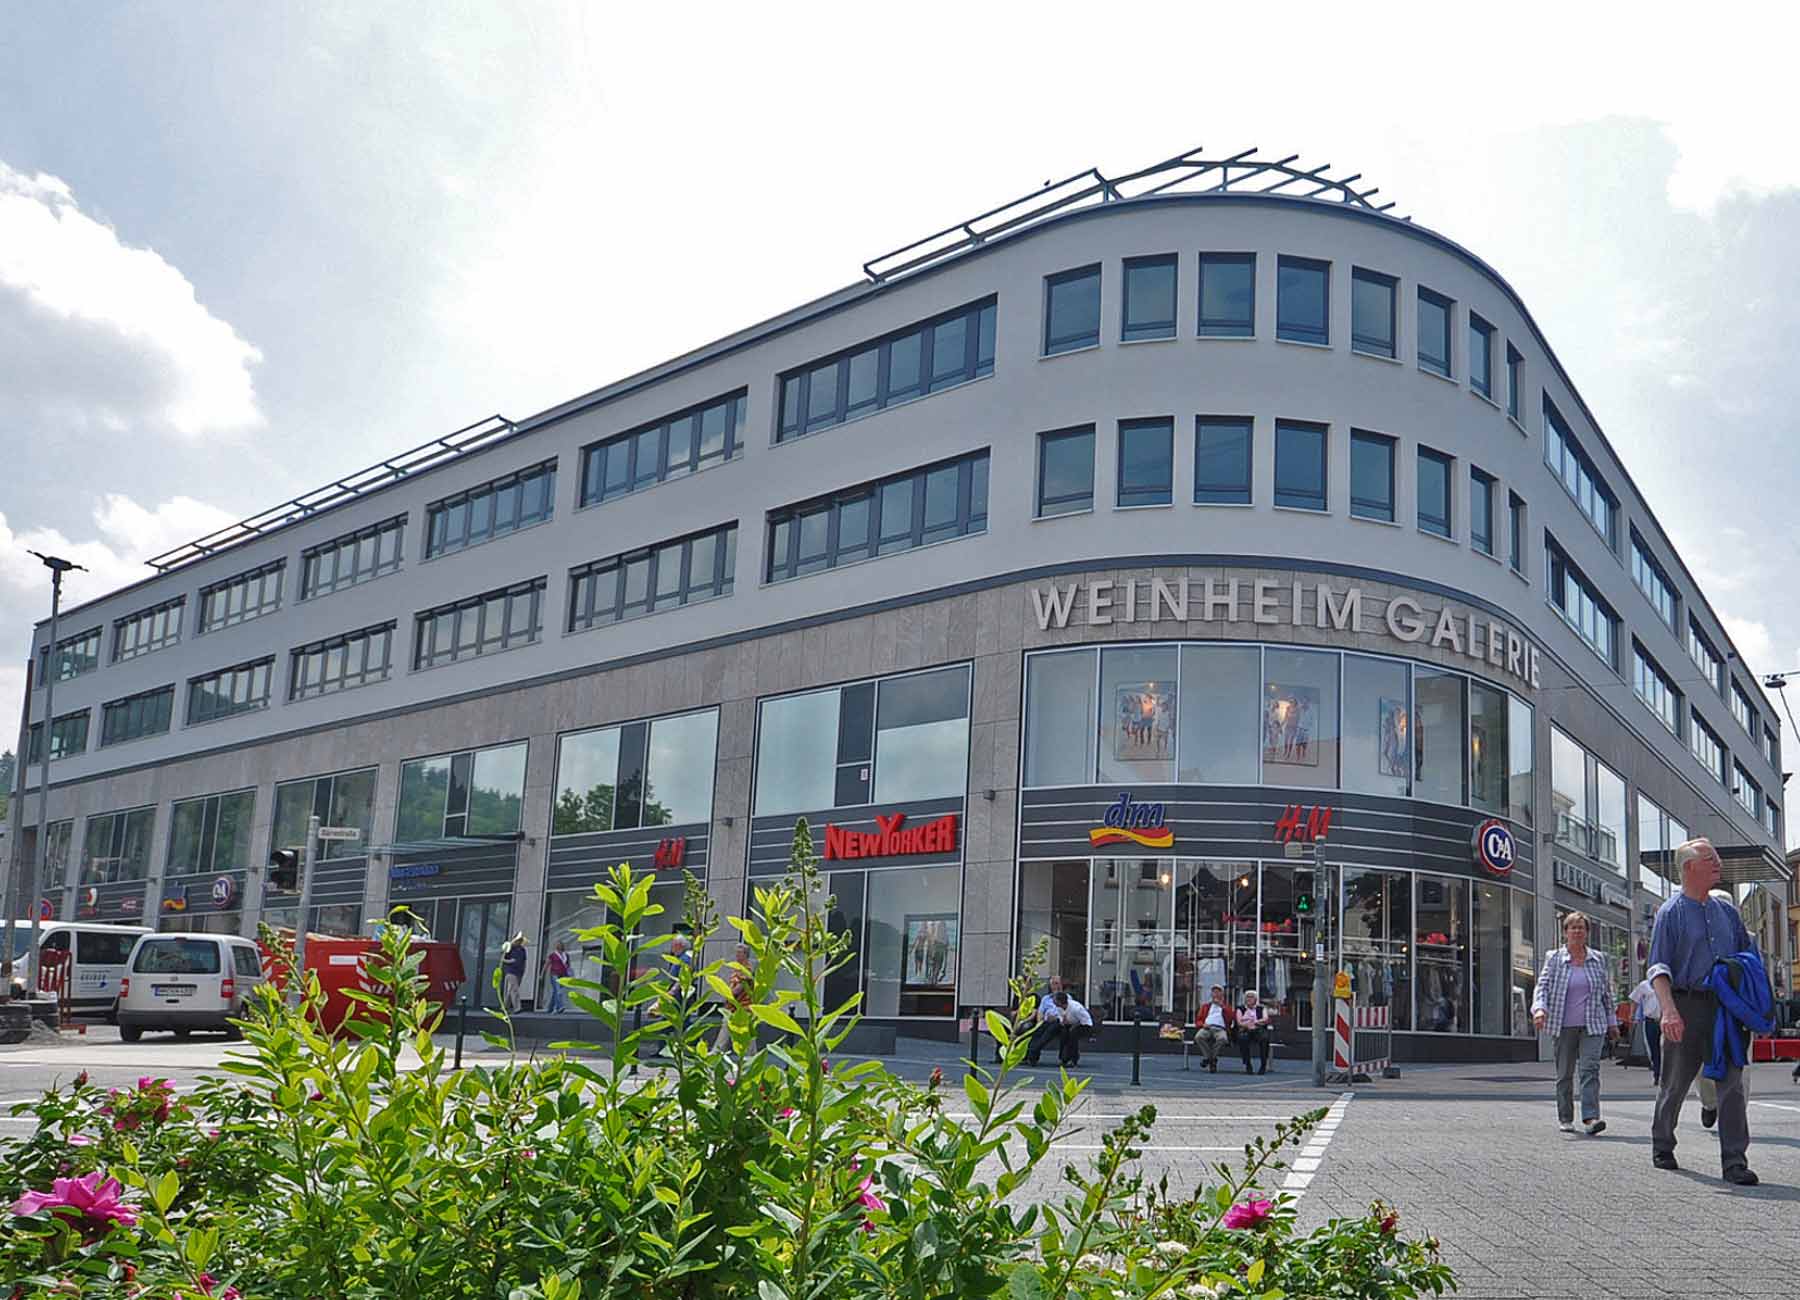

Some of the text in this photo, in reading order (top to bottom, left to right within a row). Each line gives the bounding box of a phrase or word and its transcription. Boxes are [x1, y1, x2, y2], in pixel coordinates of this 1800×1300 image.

[1032, 577, 1541, 690] WEINHEIM GALERIE
[1103, 792, 1166, 829] dm
[1274, 803, 1333, 846] H&M
